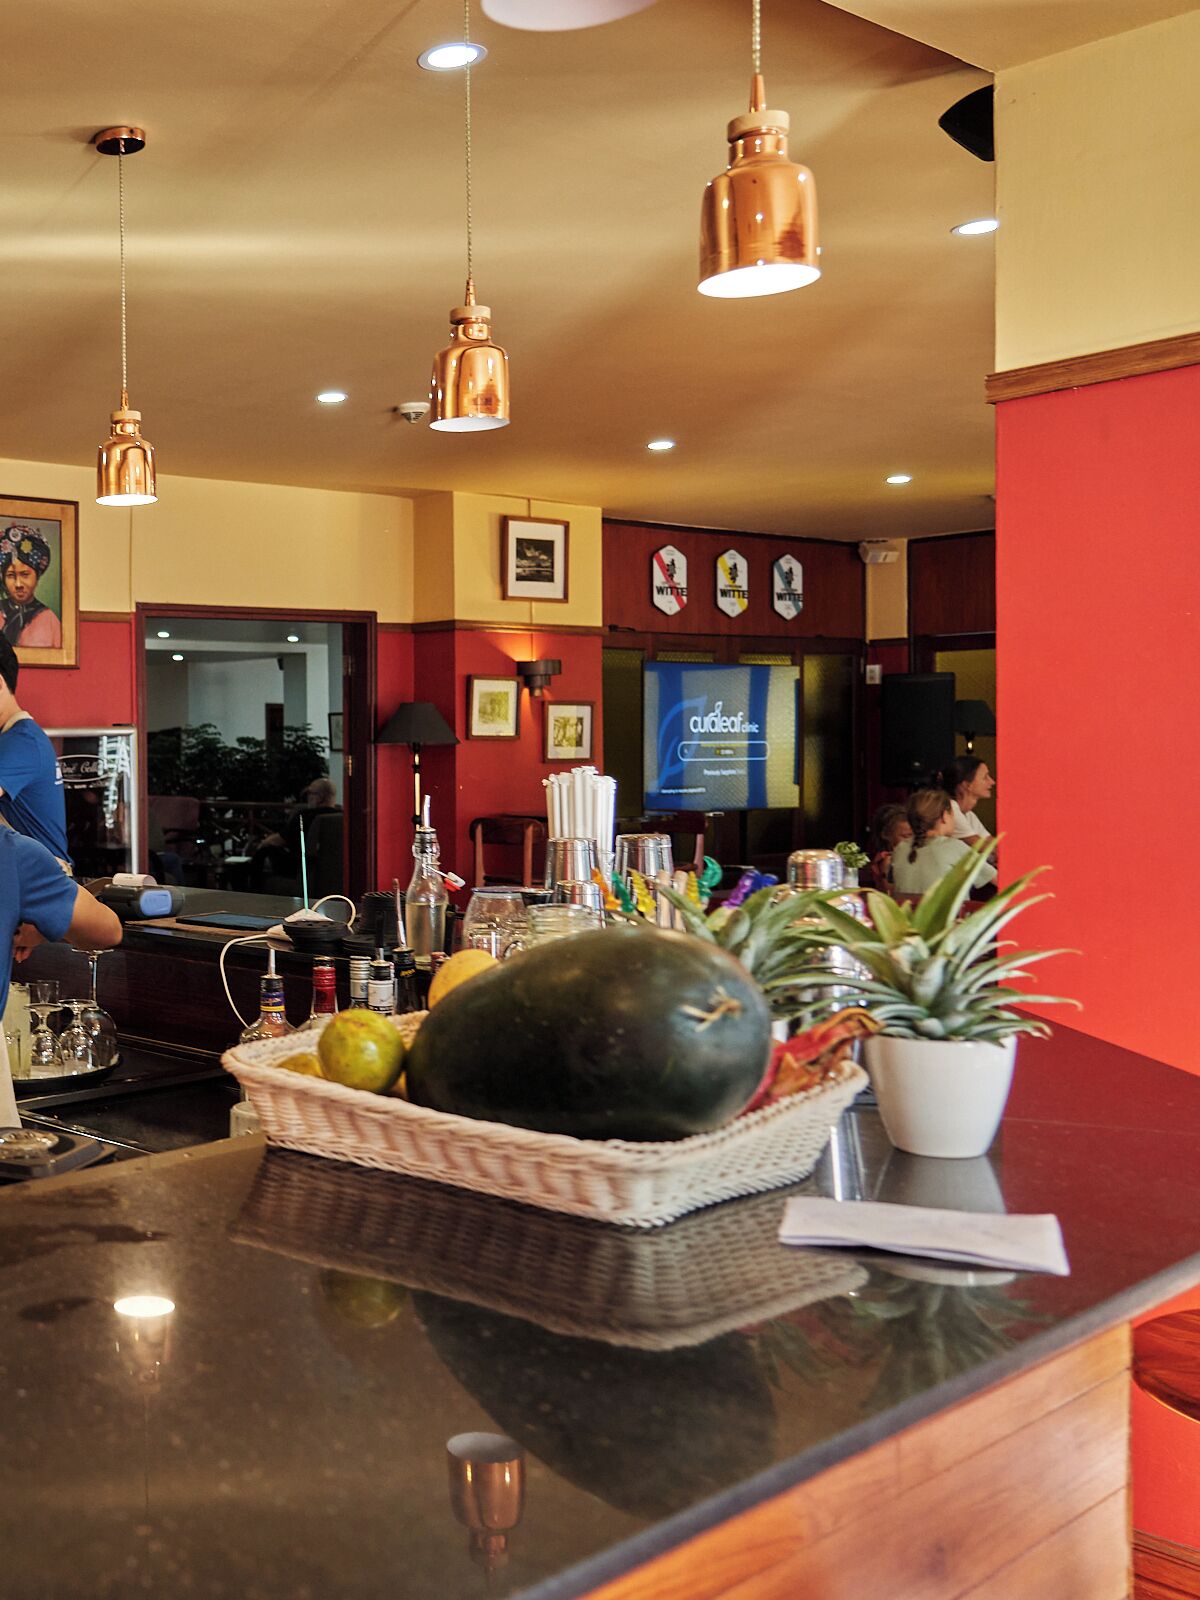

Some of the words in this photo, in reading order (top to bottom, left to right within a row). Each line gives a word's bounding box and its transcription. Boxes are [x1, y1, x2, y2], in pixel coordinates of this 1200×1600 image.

[655, 585, 688, 597] WITTE
[720, 588, 749, 600] WITTE
[776, 591, 804, 603] WITTE
[689, 702, 744, 733] curaleaf
